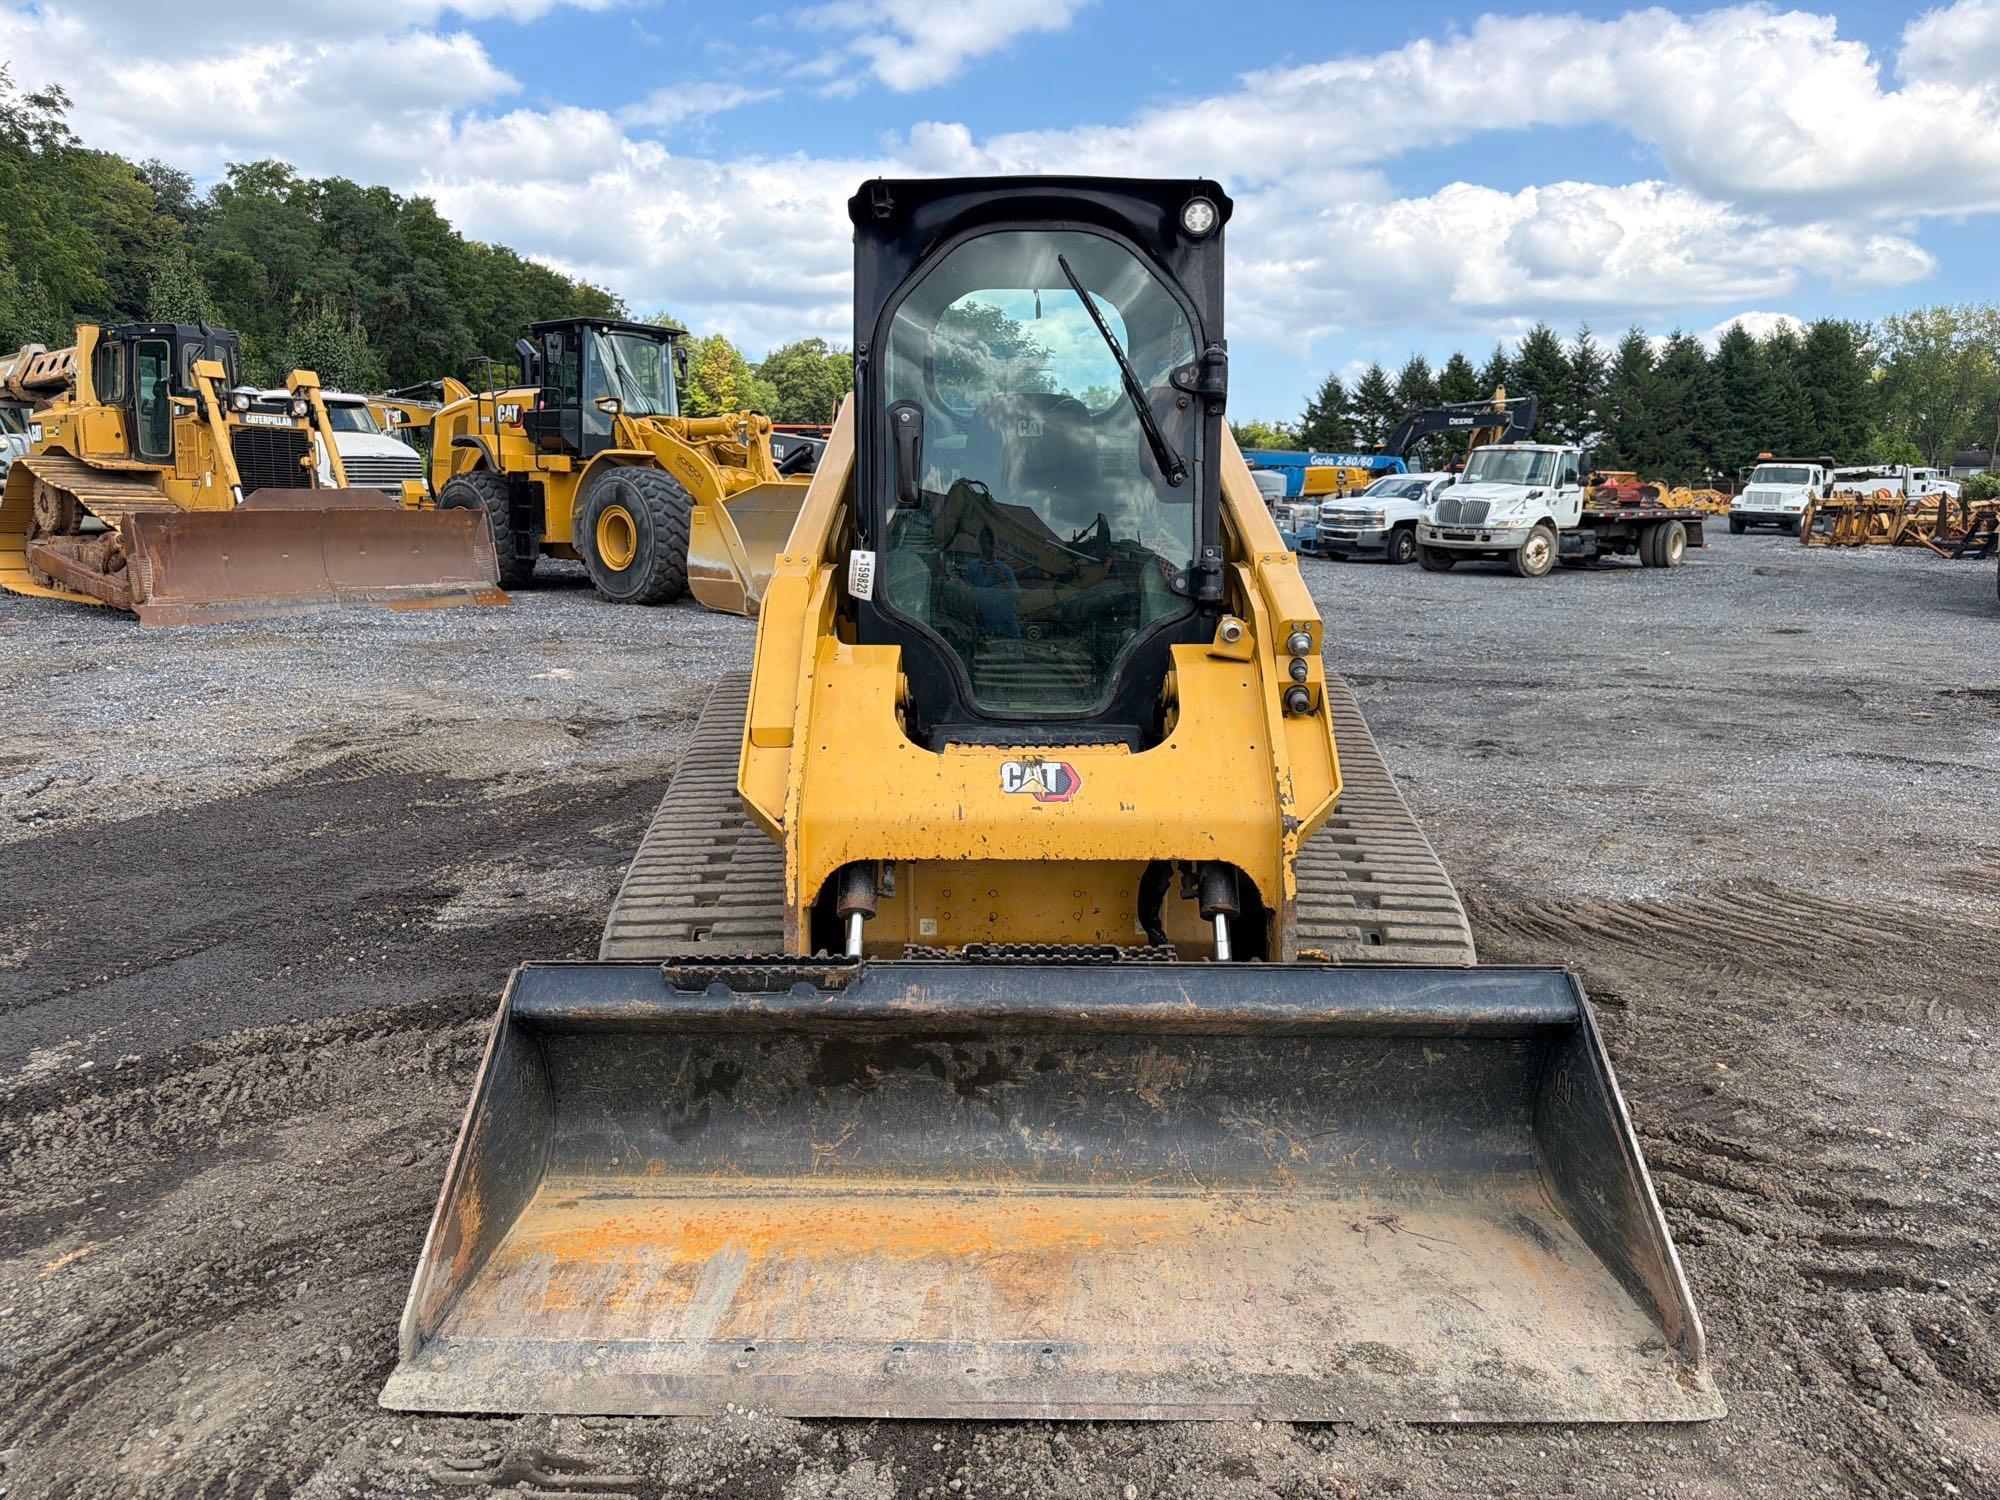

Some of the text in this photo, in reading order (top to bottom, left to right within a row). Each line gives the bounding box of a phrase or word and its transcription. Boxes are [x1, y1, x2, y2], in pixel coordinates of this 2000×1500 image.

[246, 414, 292, 426] CATERPILLAR
[498, 404, 519, 423] CAT
[1449, 417, 1474, 425] DEERE
[31, 424, 42, 441] CAT
[1017, 419, 1045, 437] CAT
[773, 444, 785, 458] TH
[1310, 455, 1373, 467] Genie Z-80/60
[857, 562, 871, 594] 159823
[1001, 762, 1061, 793] CAT
